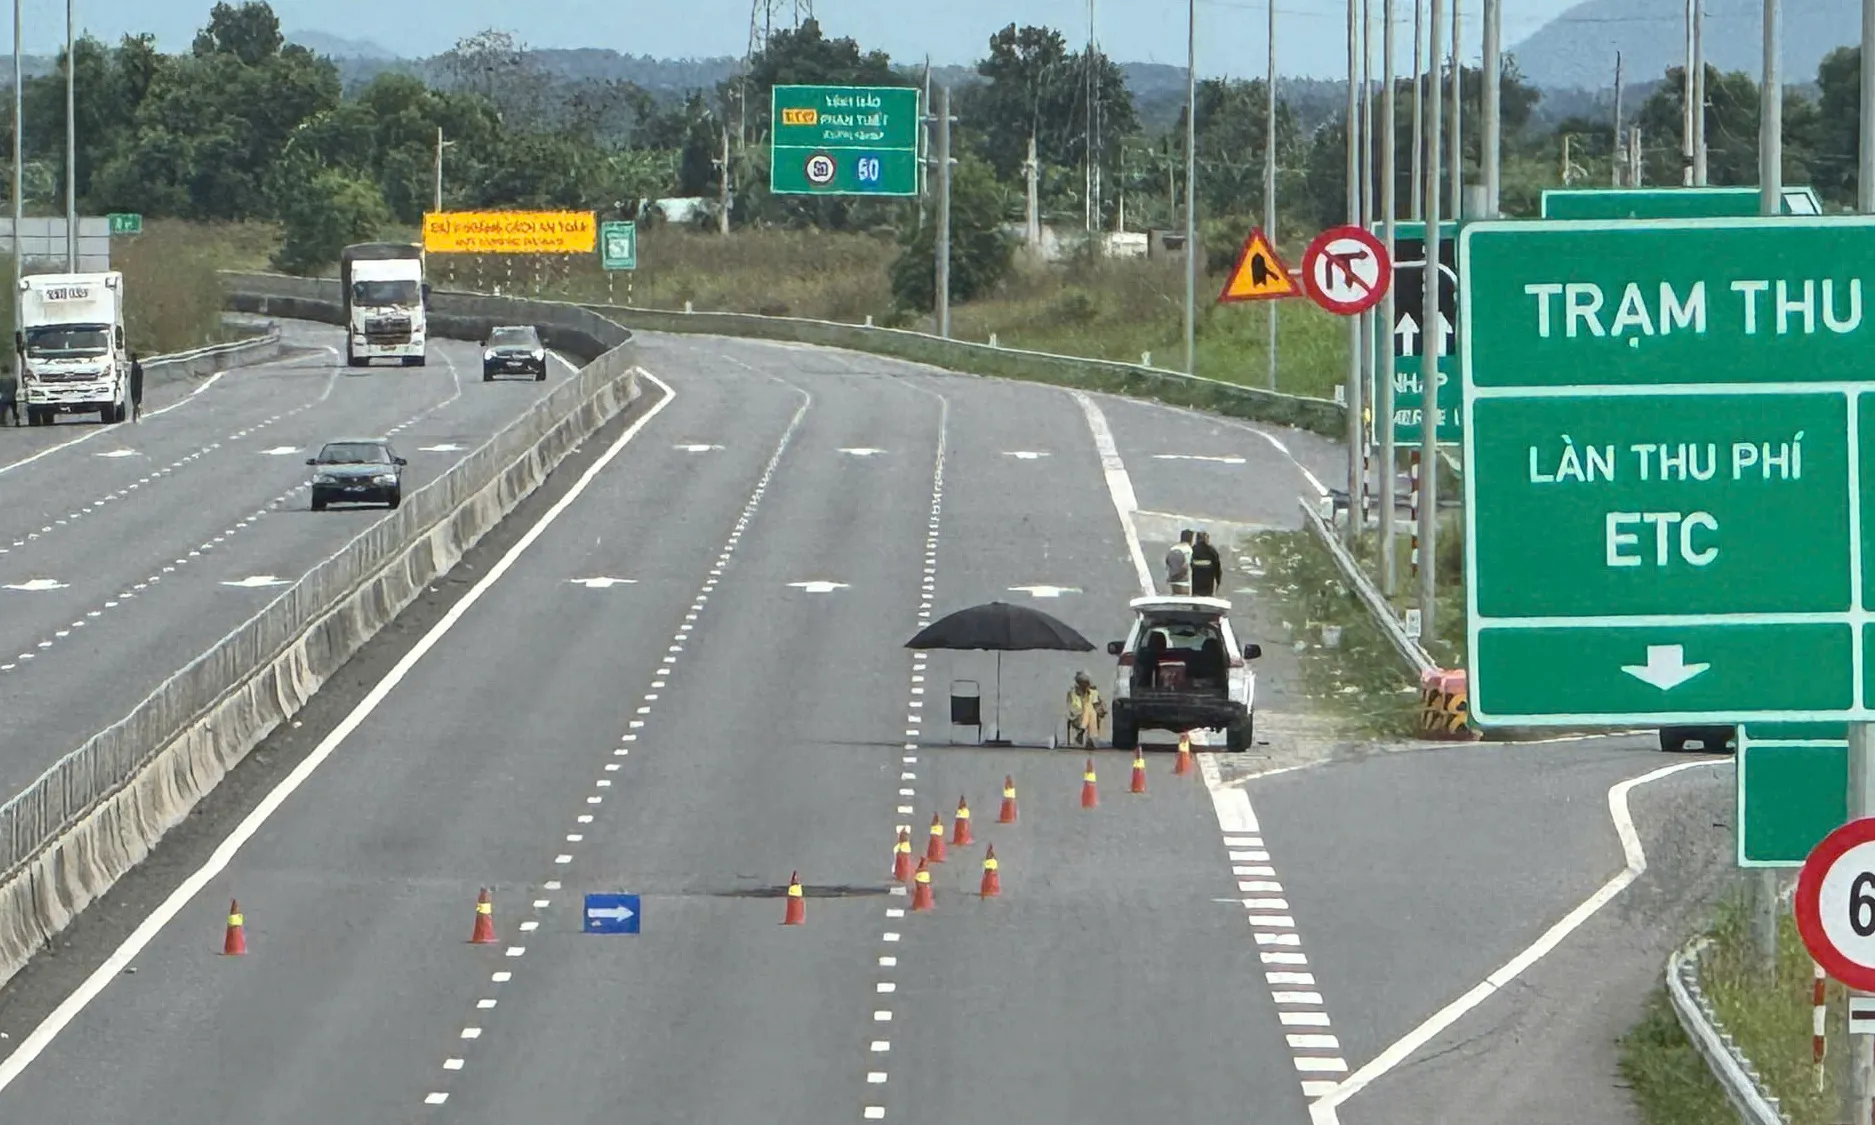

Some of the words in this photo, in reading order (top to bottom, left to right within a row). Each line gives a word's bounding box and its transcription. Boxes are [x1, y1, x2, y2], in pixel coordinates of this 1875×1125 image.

[1524, 281, 1707, 348] TRẠM
[1730, 279, 1862, 335] THU
[1392, 372, 1448, 394] NHP
[1529, 434, 1615, 483] LÀN
[1631, 443, 1717, 481] THU
[1732, 430, 1804, 480] PHÍ
[1606, 511, 1719, 567] ETC
